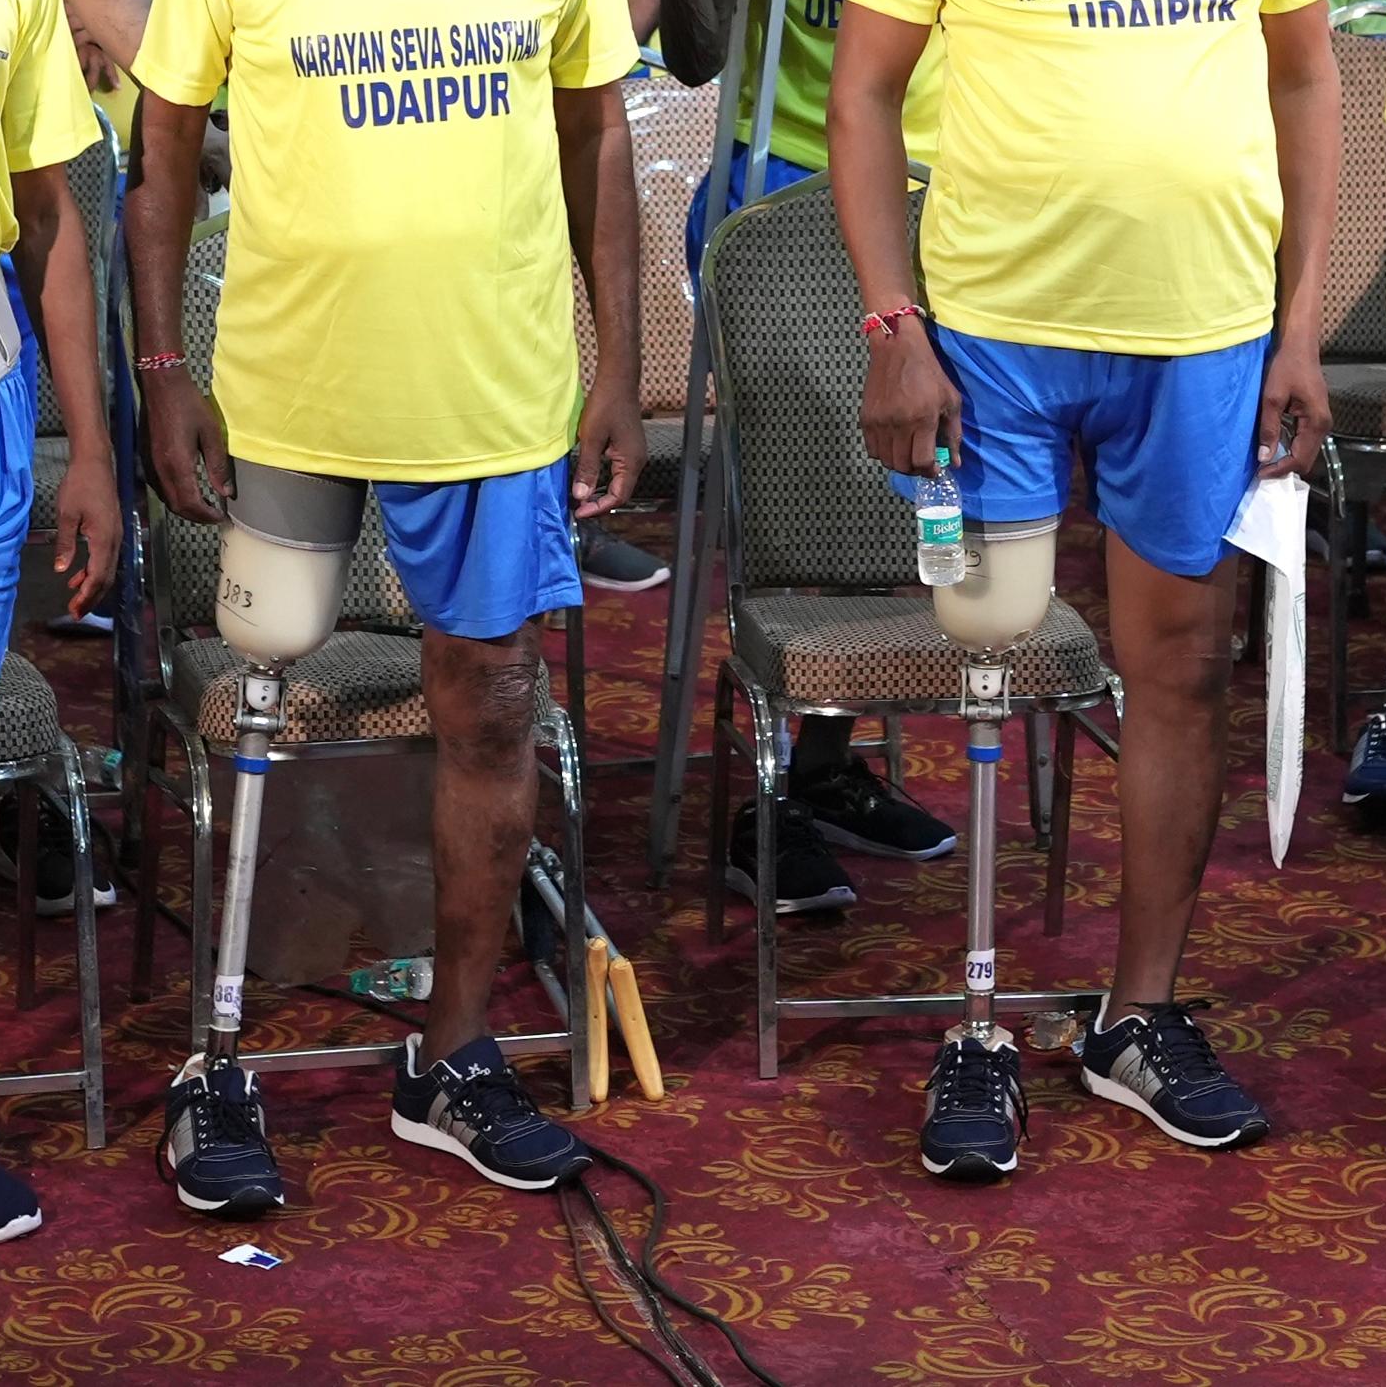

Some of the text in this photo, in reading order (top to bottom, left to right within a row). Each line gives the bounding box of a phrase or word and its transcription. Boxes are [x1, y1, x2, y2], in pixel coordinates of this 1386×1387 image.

[290, 29, 385, 79] NARAYAN
[391, 26, 445, 72] SEVA
[340, 71, 511, 130] UDAIPUR
[967, 961, 992, 980] 279
